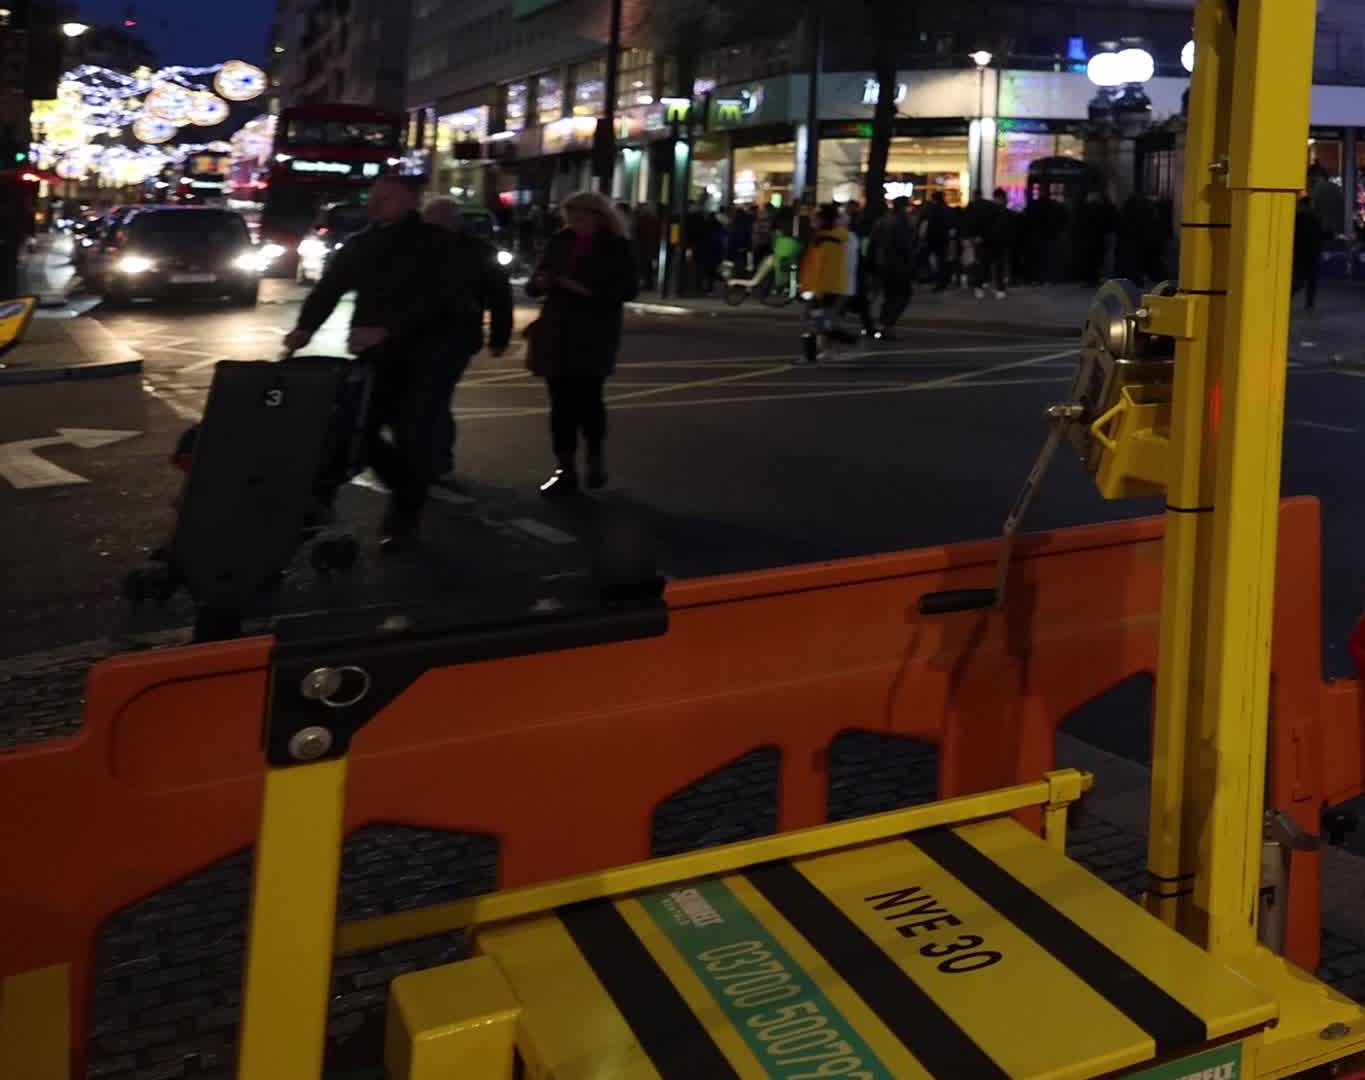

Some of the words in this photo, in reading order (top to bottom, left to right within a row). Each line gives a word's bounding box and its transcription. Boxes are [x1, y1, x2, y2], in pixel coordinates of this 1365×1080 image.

[264, 389, 284, 407] 3
[863, 885, 963, 939] NYE
[918, 934, 1003, 974] 30
[697, 939, 803, 1009] 03700
[745, 1000, 876, 1080] 50079
